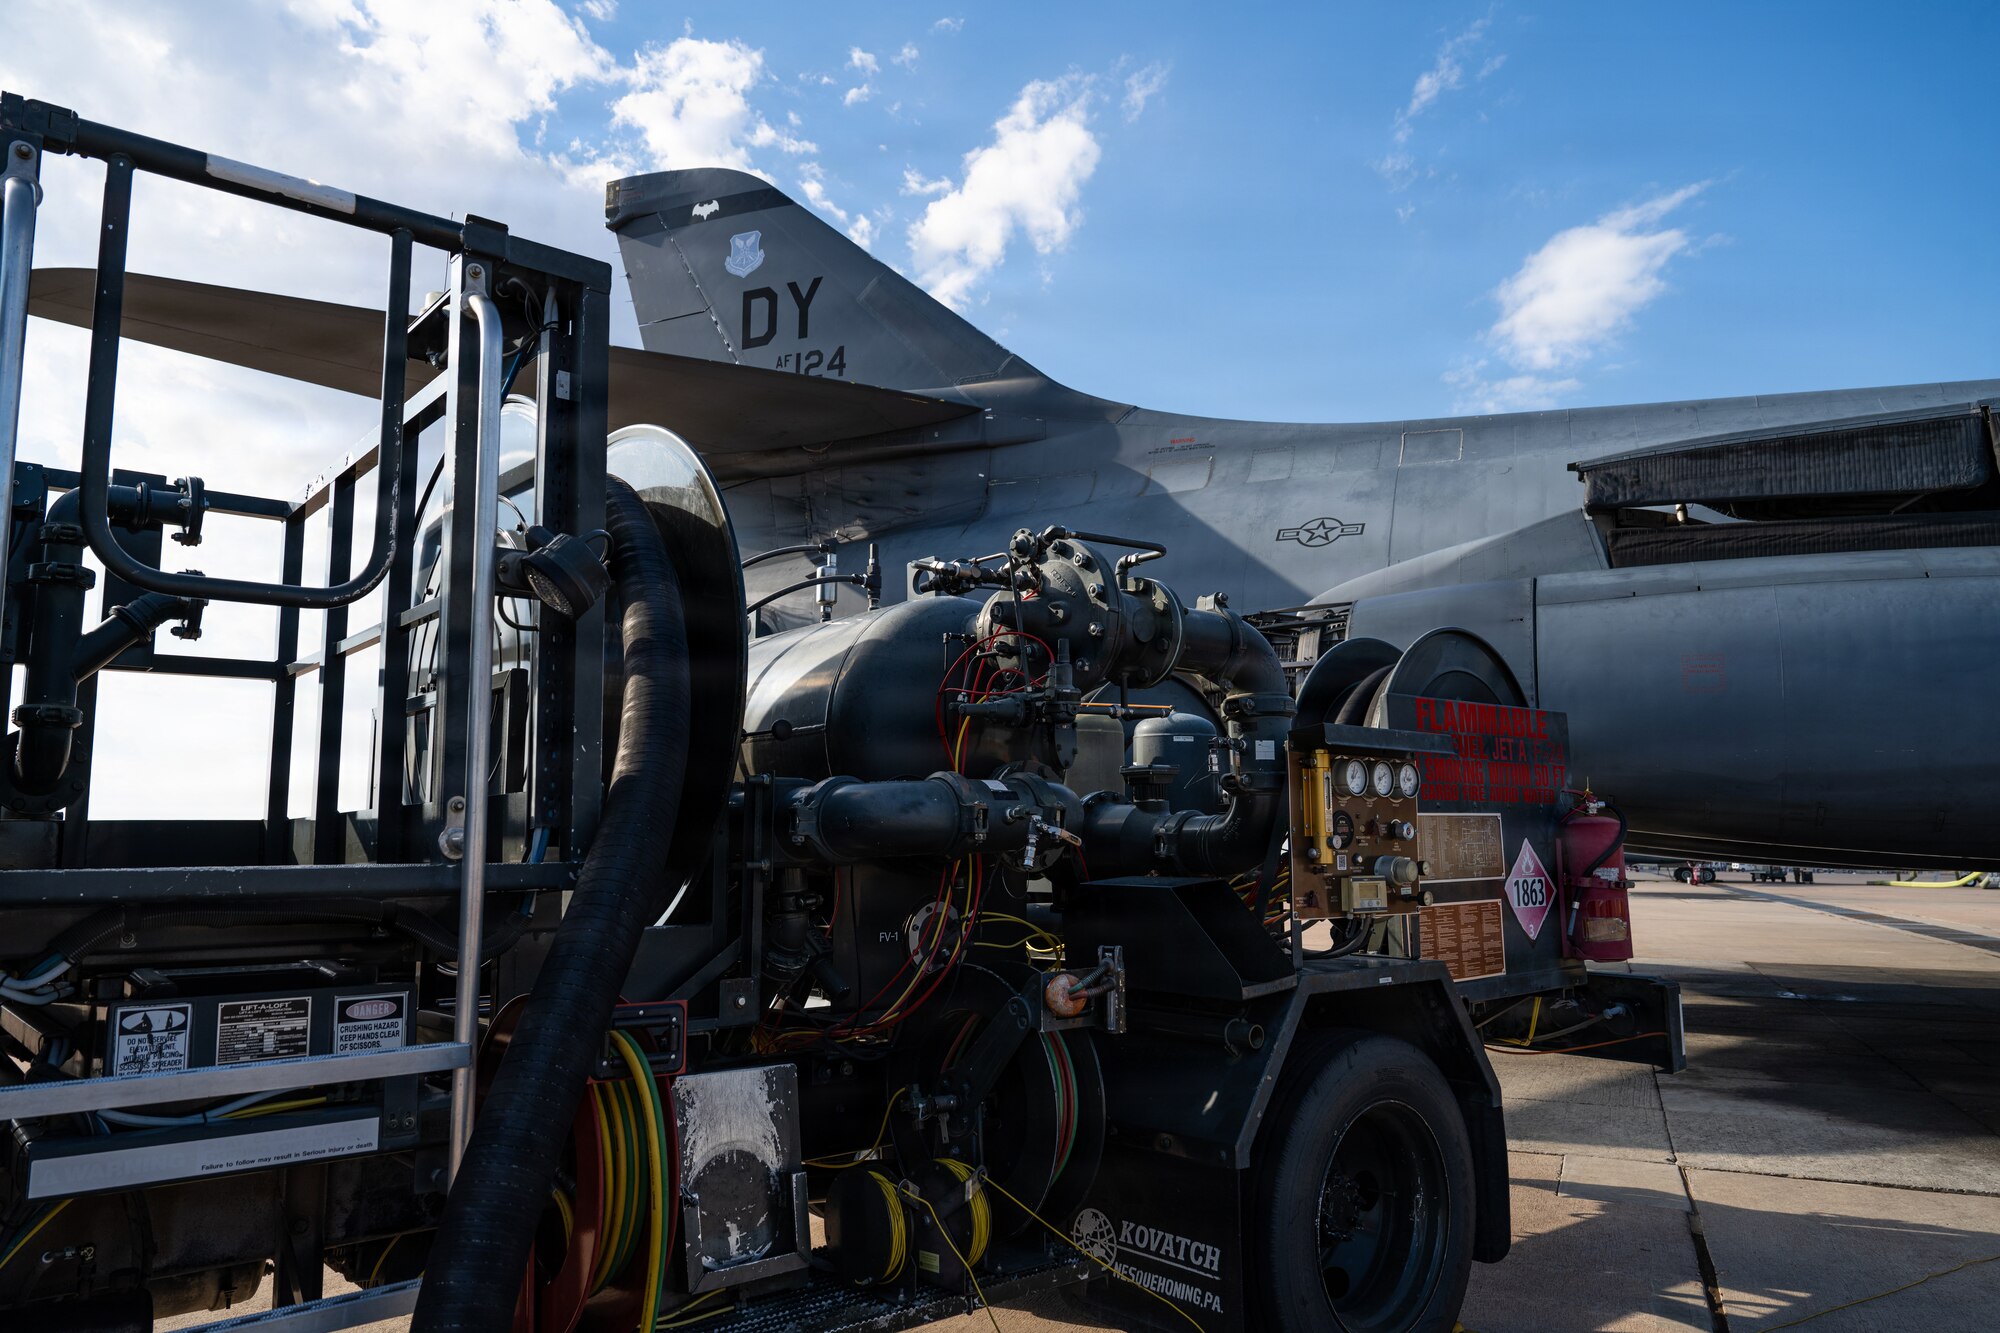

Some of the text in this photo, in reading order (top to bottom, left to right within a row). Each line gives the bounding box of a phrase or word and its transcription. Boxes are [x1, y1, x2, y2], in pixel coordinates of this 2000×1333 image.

[742, 276, 823, 350] DY
[776, 345, 846, 377] AF 124
[1416, 697, 1548, 739] FLAMMABLE
[1492, 737, 1514, 761] JET
[1518, 739, 1527, 762] A
[1425, 757, 1484, 785] SMOKING
[1488, 762, 1530, 786] WITHIN
[1534, 764, 1549, 787] 50
[1553, 765, 1566, 787] FT
[1421, 784, 1555, 804] CARGO FIRE AVOID WATER
[1514, 878, 1545, 907] 1863
[879, 931, 899, 943] FV-1
[1529, 923, 1535, 937] 3
[240, 1002, 289, 1011] LIFT-A-LOFT
[353, 1003, 390, 1017] DANGER
[340, 1021, 399, 1034] CRUSHING HAZARD
[340, 1030, 400, 1042] KEEP HANDS CLEAR
[127, 1038, 136, 1046] DO
[339, 1040, 382, 1051] OF SCISSORS.
[119, 1059, 183, 1072] SCISSORS SPREADER
[201, 1163, 224, 1171] Failure
[235, 1158, 255, 1166] follow
[257, 1156, 272, 1164] may
[274, 1153, 292, 1161] result
[302, 1148, 326, 1157] Serious
[328, 1146, 345, 1154] injury
[1118, 1219, 1221, 1272] KOVATCH
